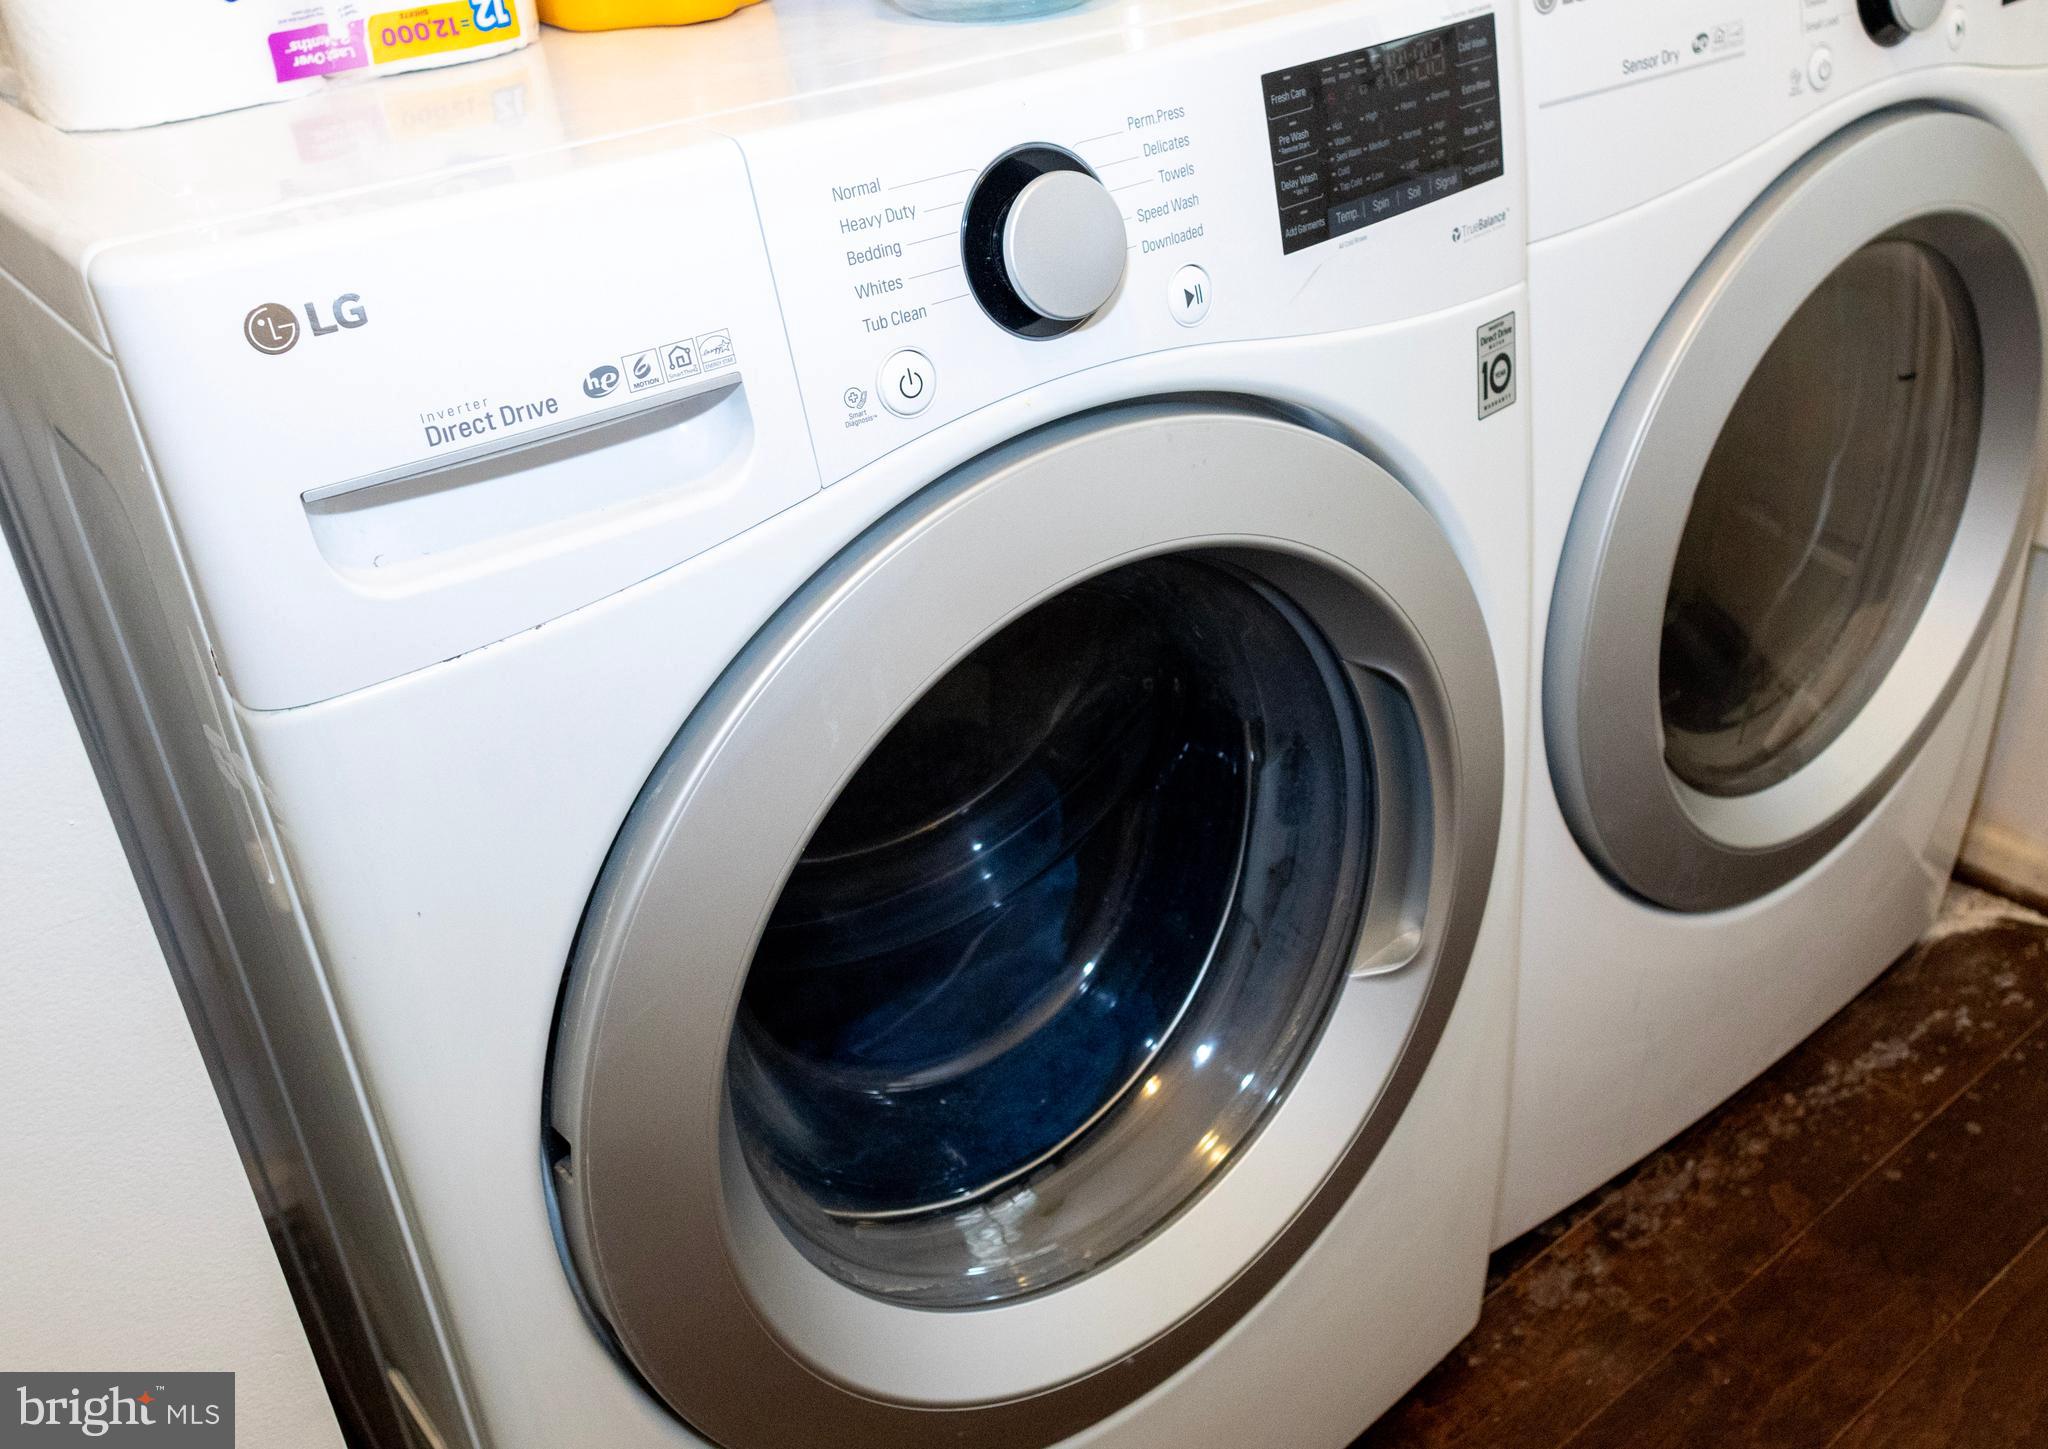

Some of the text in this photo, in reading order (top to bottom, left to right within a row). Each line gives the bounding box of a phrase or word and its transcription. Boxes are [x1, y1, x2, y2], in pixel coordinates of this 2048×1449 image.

[468, 0, 511, 32] 12
[382, 17, 460, 46] 12,000
[293, 51, 326, 67] Over
[1622, 49, 1680, 75] Sensor Dry
[1270, 88, 1307, 104] Fresh Care
[1127, 106, 1185, 131] Perm.Press
[1143, 135, 1190, 157] Delicates
[1279, 129, 1309, 145] Pre Wash
[1158, 163, 1195, 184] Towels
[1280, 172, 1318, 191] Delay Wash
[832, 178, 881, 202] Normal
[1336, 172, 1458, 224] Temp. Spin Soil Signal
[839, 204, 916, 235] Heavy Duty
[1137, 194, 1200, 223] Speed Wash
[1142, 223, 1204, 254] Downloaded
[1285, 218, 1326, 238] Add Garments
[847, 242, 902, 266] Bedding
[854, 277, 904, 300] Whites
[304, 293, 369, 337] LG
[862, 306, 928, 334] Tub Clean
[633, 376, 660, 389] MOTION
[1482, 352, 1512, 400] 10
[420, 398, 487, 424] Inverter
[425, 398, 559, 447] Direct Drive
